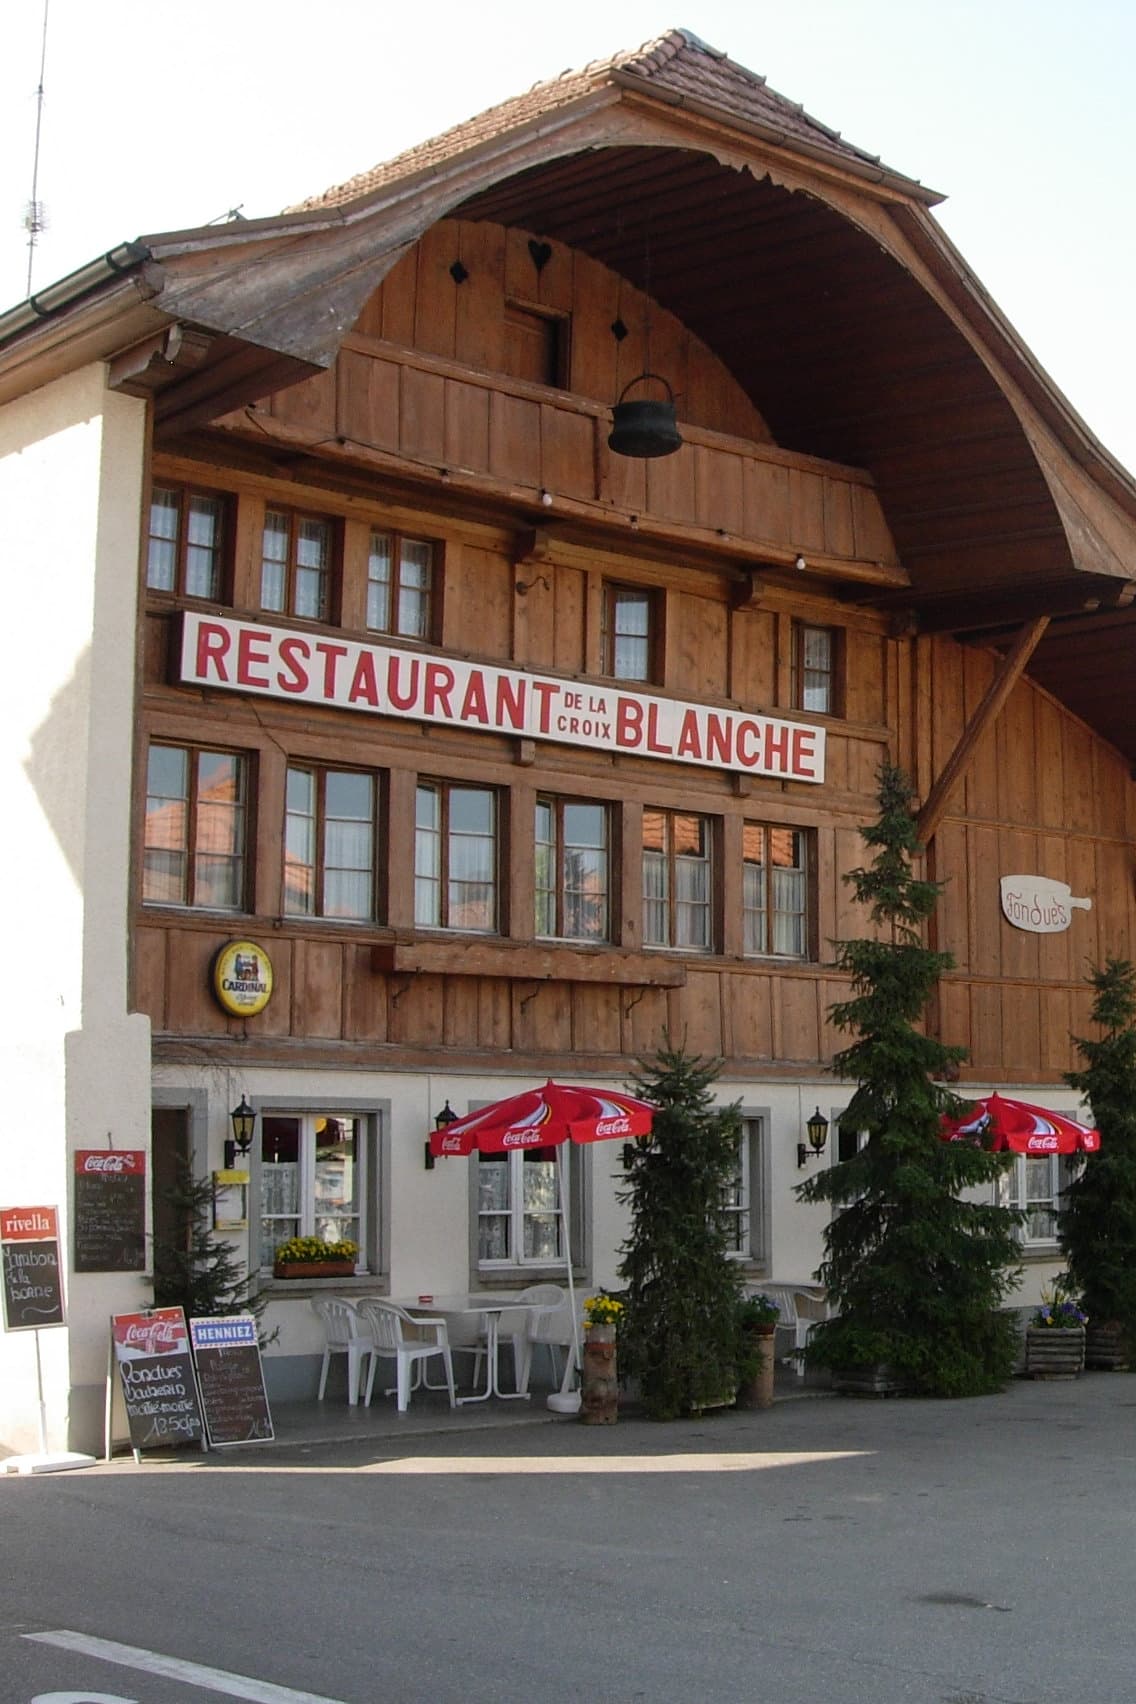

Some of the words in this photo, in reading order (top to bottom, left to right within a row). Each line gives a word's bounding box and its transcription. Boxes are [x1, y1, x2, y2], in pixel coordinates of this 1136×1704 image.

[195, 621, 560, 733] RESTAURANT
[564, 691, 582, 710] DE
[589, 695, 607, 714] LA
[557, 715, 611, 740] CROIX
[616, 696, 816, 777] BLANCHE
[5, 1213, 51, 1233] rivella
[197, 1326, 252, 1340] HENNIEZ
